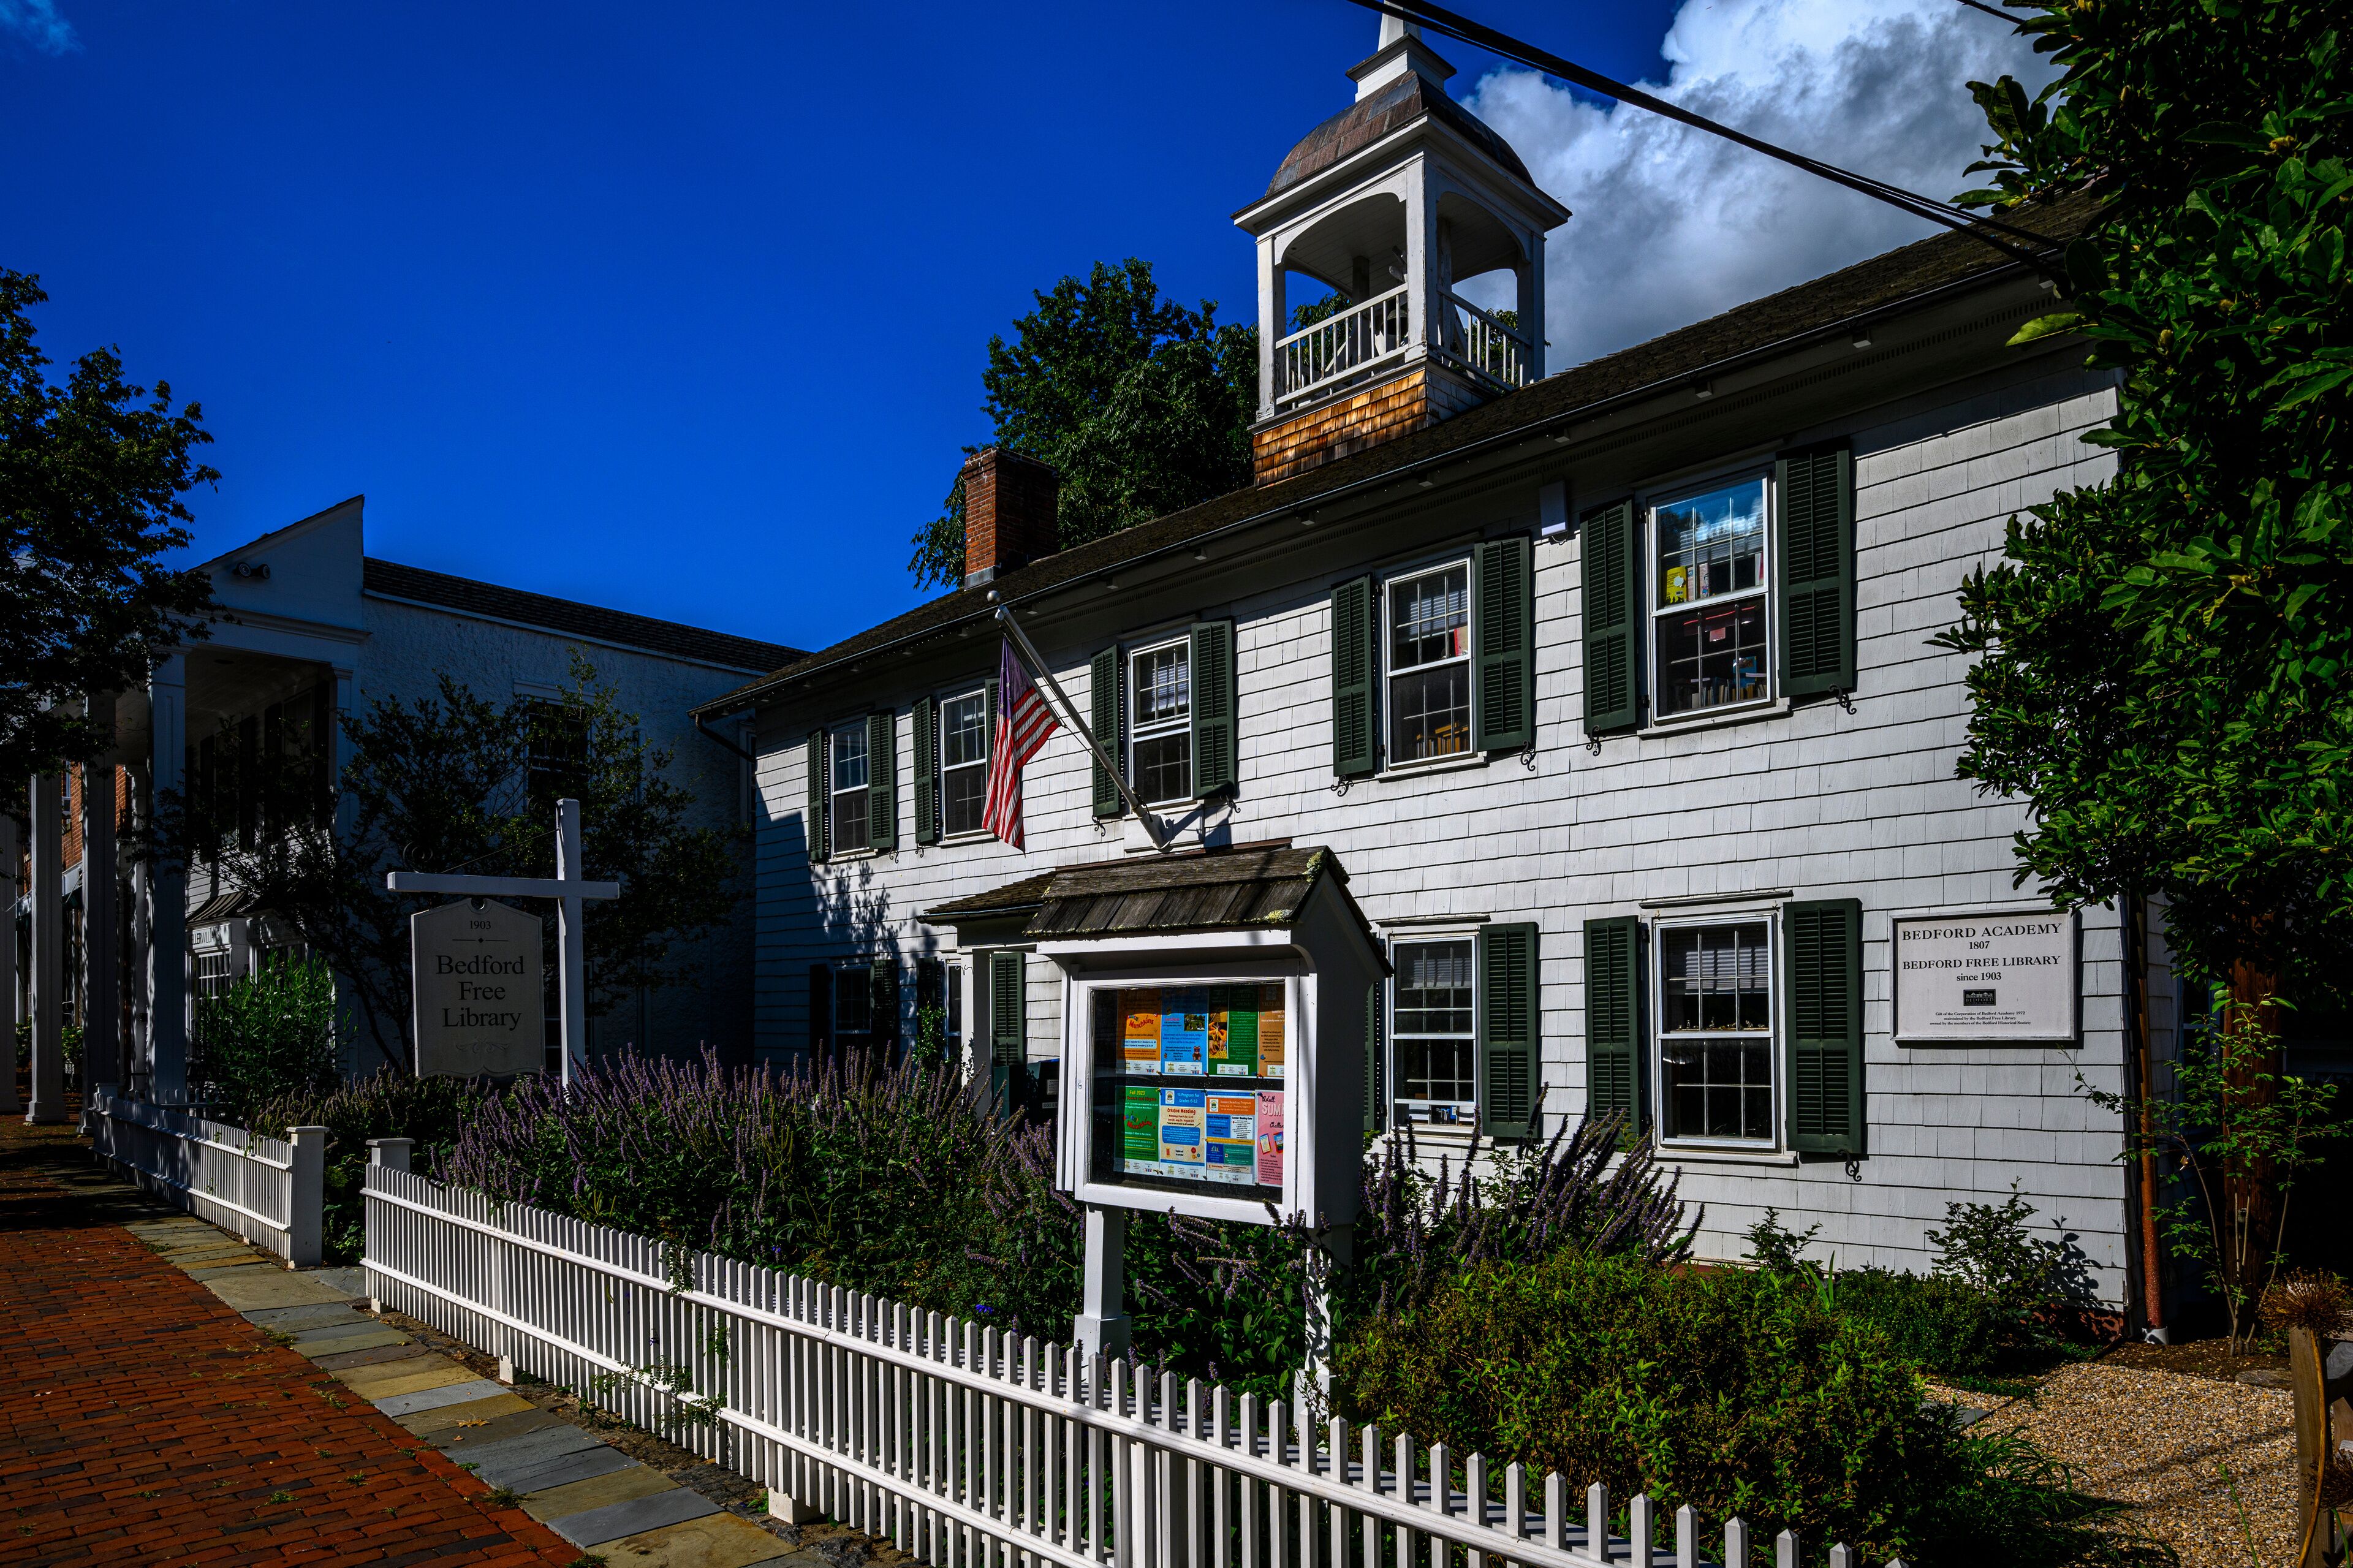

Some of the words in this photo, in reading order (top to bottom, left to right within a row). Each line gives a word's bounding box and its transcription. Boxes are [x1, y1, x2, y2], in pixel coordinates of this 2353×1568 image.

[470, 920, 491, 929] 1903
[1902, 928, 1976, 941] BEDFORD
[1981, 923, 2062, 937] ACADEMY
[1969, 941, 1990, 950] 1807
[436, 955, 525, 974] Bedford
[1903, 959, 1962, 969] BEDFORD
[1966, 958, 1999, 968] FREE
[2003, 956, 2061, 966] LIBRARY
[1957, 973, 1979, 982] since
[1981, 972, 2002, 980] 1903
[458, 981, 506, 1000] Free
[442, 1007, 521, 1031] Library
[1129, 1017, 1154, 1029] Munchkins
[1127, 1119, 1152, 1129] Munchkins
